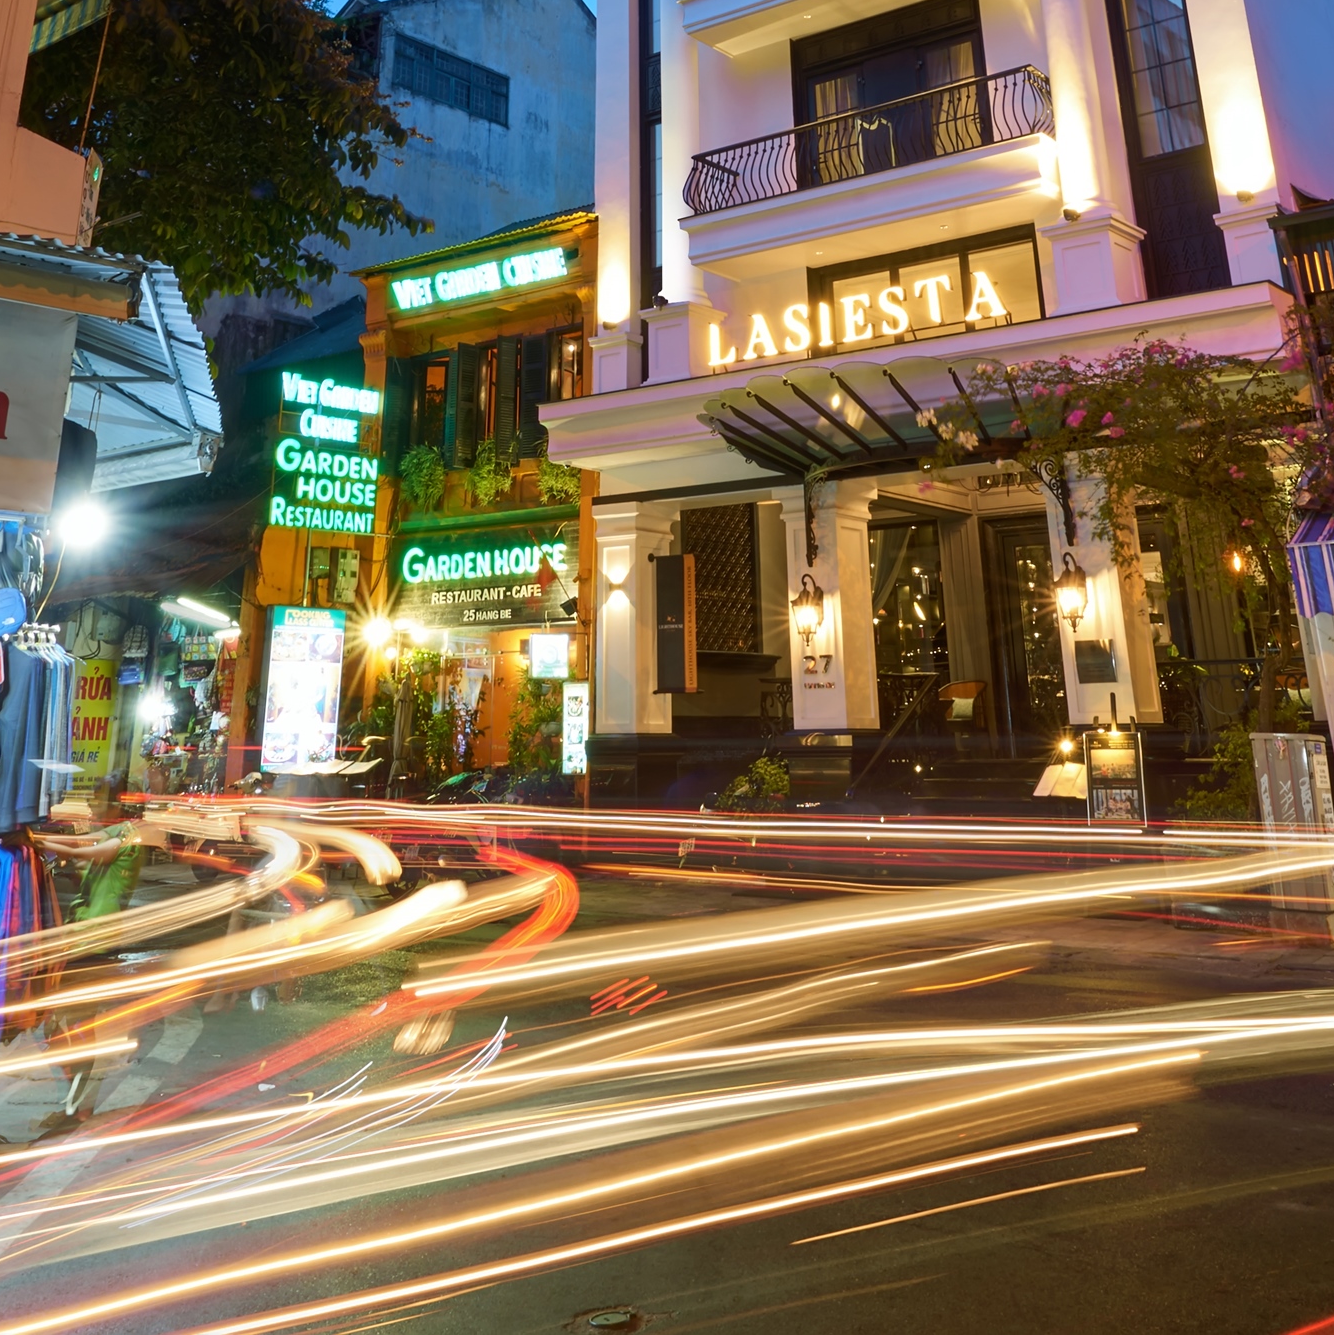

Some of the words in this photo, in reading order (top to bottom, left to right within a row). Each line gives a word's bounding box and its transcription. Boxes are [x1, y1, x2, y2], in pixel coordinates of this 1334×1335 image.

[276, 438, 378, 481] GARDEN
[297, 476, 377, 507] HOUSE
[271, 496, 374, 534] RESTAURANT
[403, 547, 491, 584] GARDEN
[463, 609, 475, 622] 25
[803, 654, 834, 675] 27
[74, 666, 112, 701] RỬA
